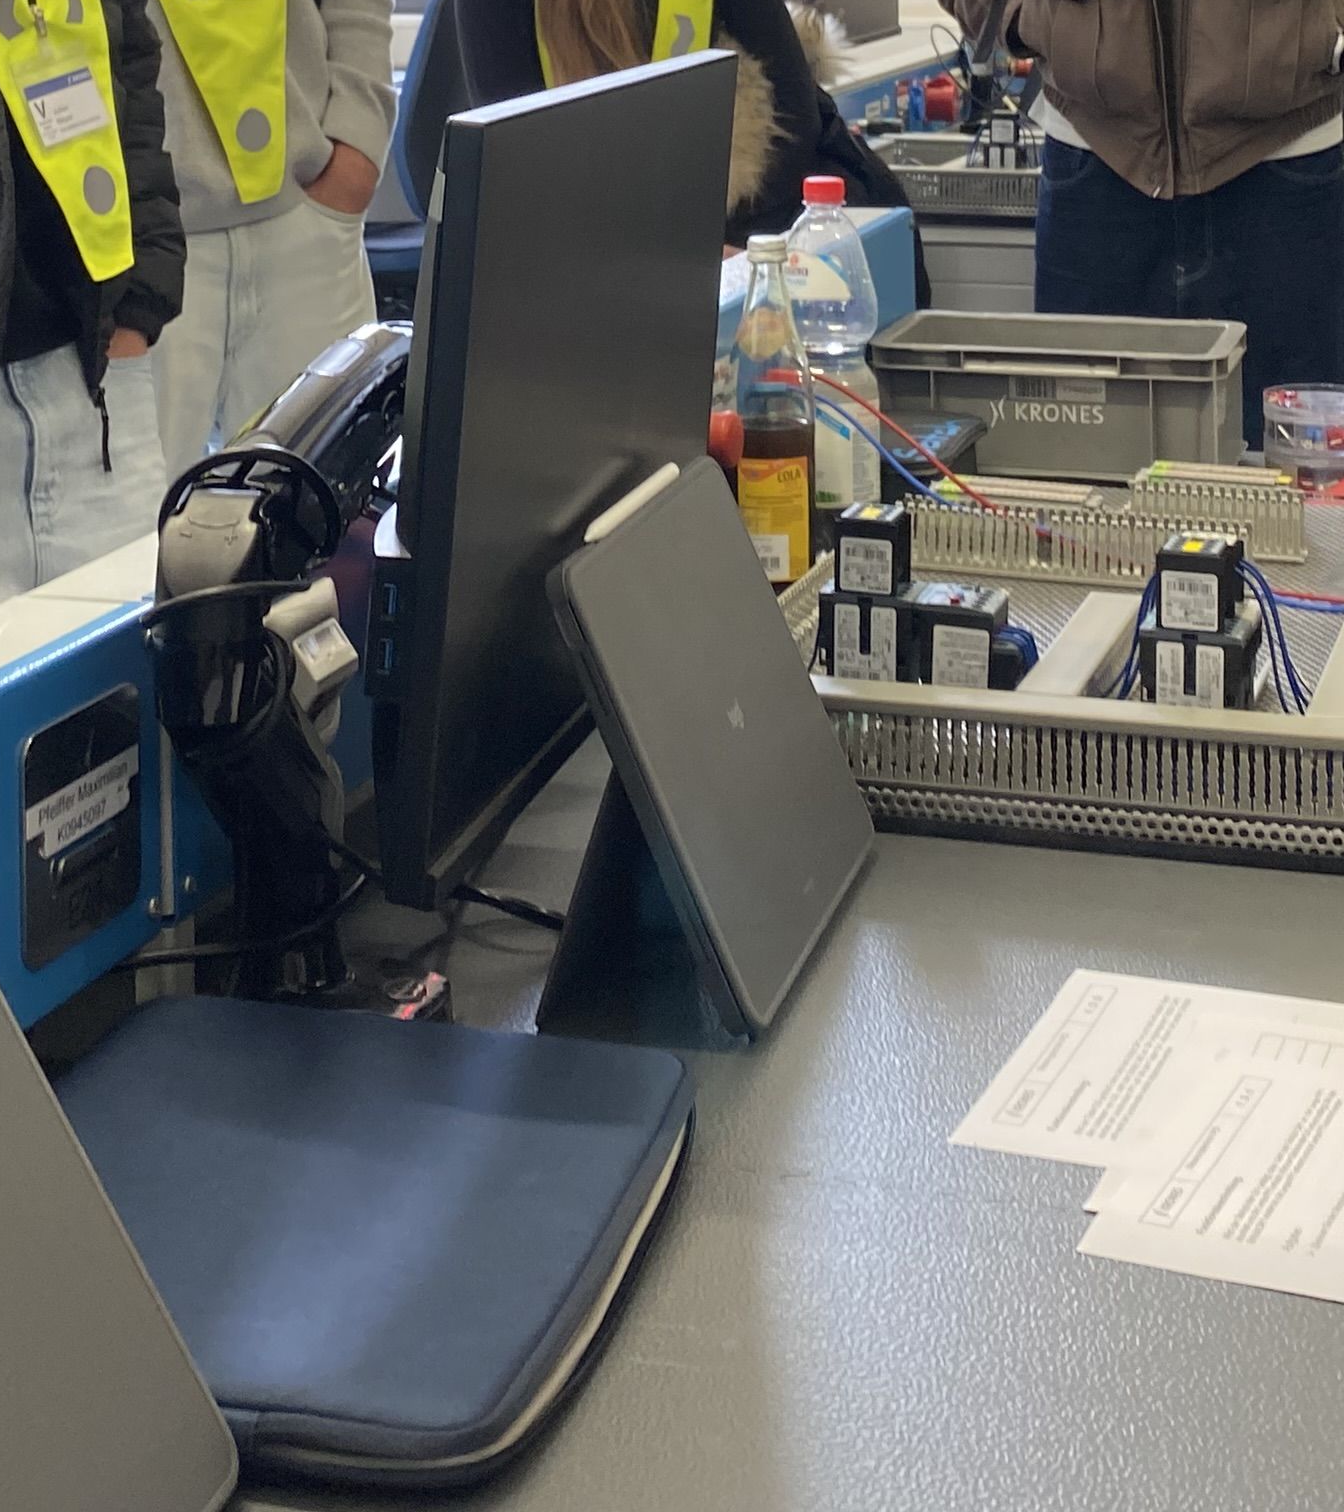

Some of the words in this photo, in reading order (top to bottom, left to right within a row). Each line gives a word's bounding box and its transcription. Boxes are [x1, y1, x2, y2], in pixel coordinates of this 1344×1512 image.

[34, 99, 46, 119] V
[1014, 402, 1104, 425] KRONES
[777, 468, 802, 483] COLA
